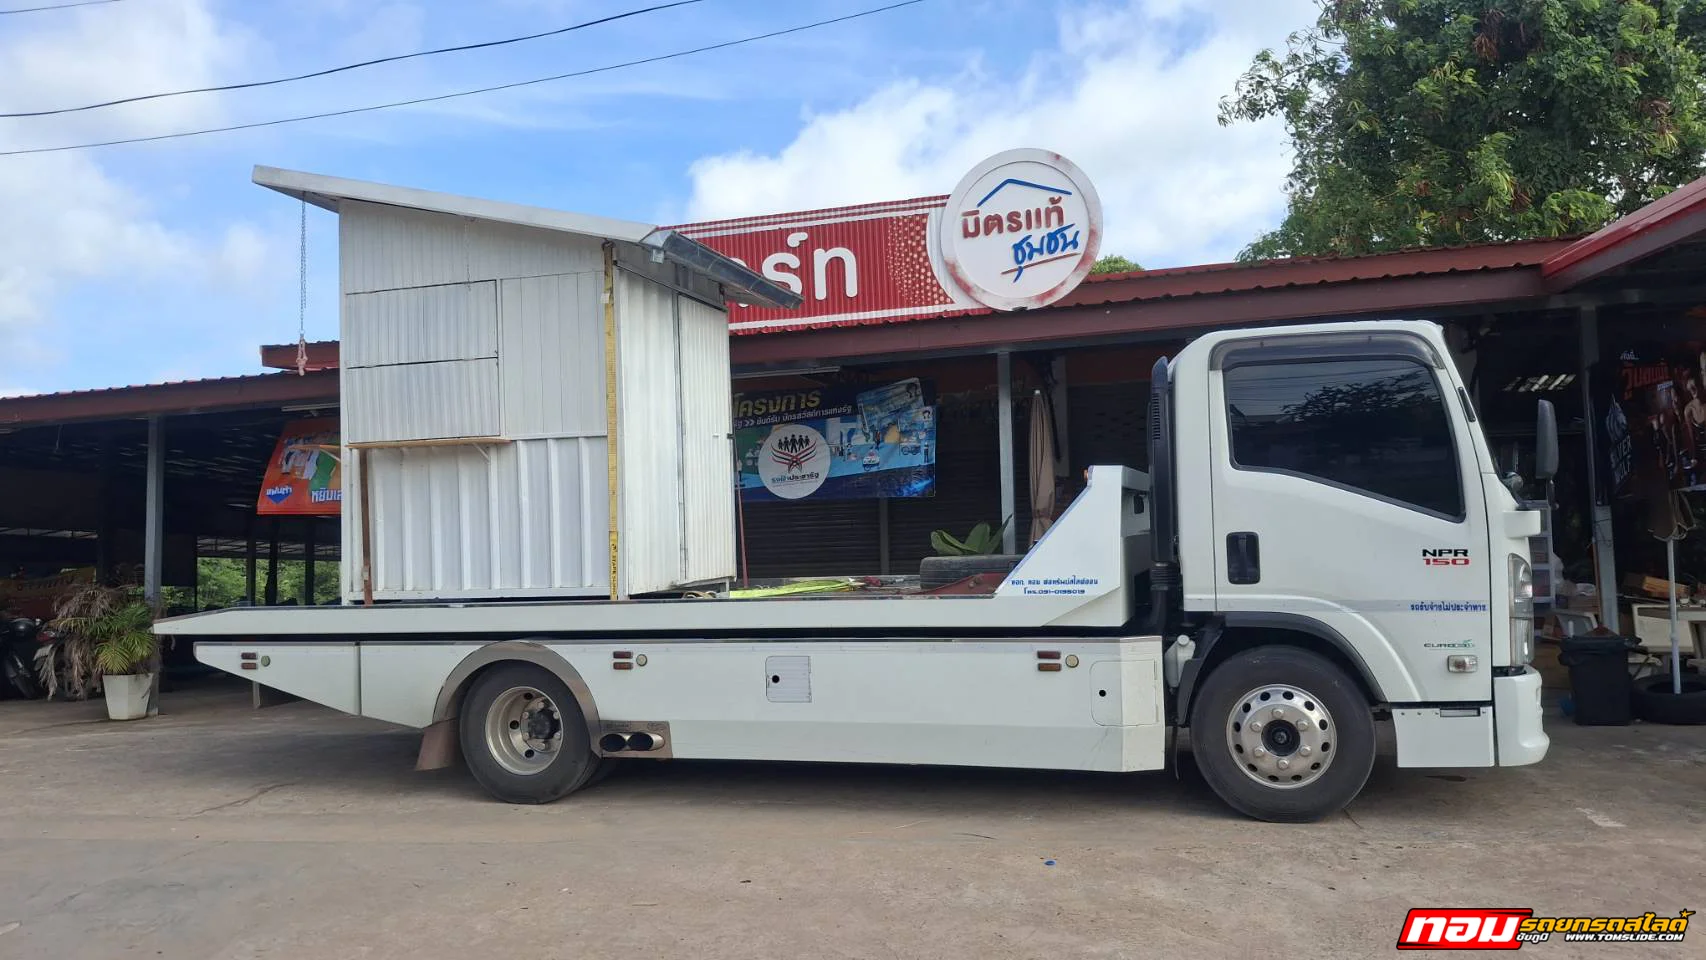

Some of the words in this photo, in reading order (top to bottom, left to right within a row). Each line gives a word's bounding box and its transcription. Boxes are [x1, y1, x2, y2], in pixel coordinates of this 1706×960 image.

[961, 195, 1064, 239] มิตรแท้
[729, 232, 858, 308] ร์ท
[1011, 223, 1080, 283] ชุมชน
[1422, 548, 1469, 557] NPR
[1423, 558, 1470, 566] 150
